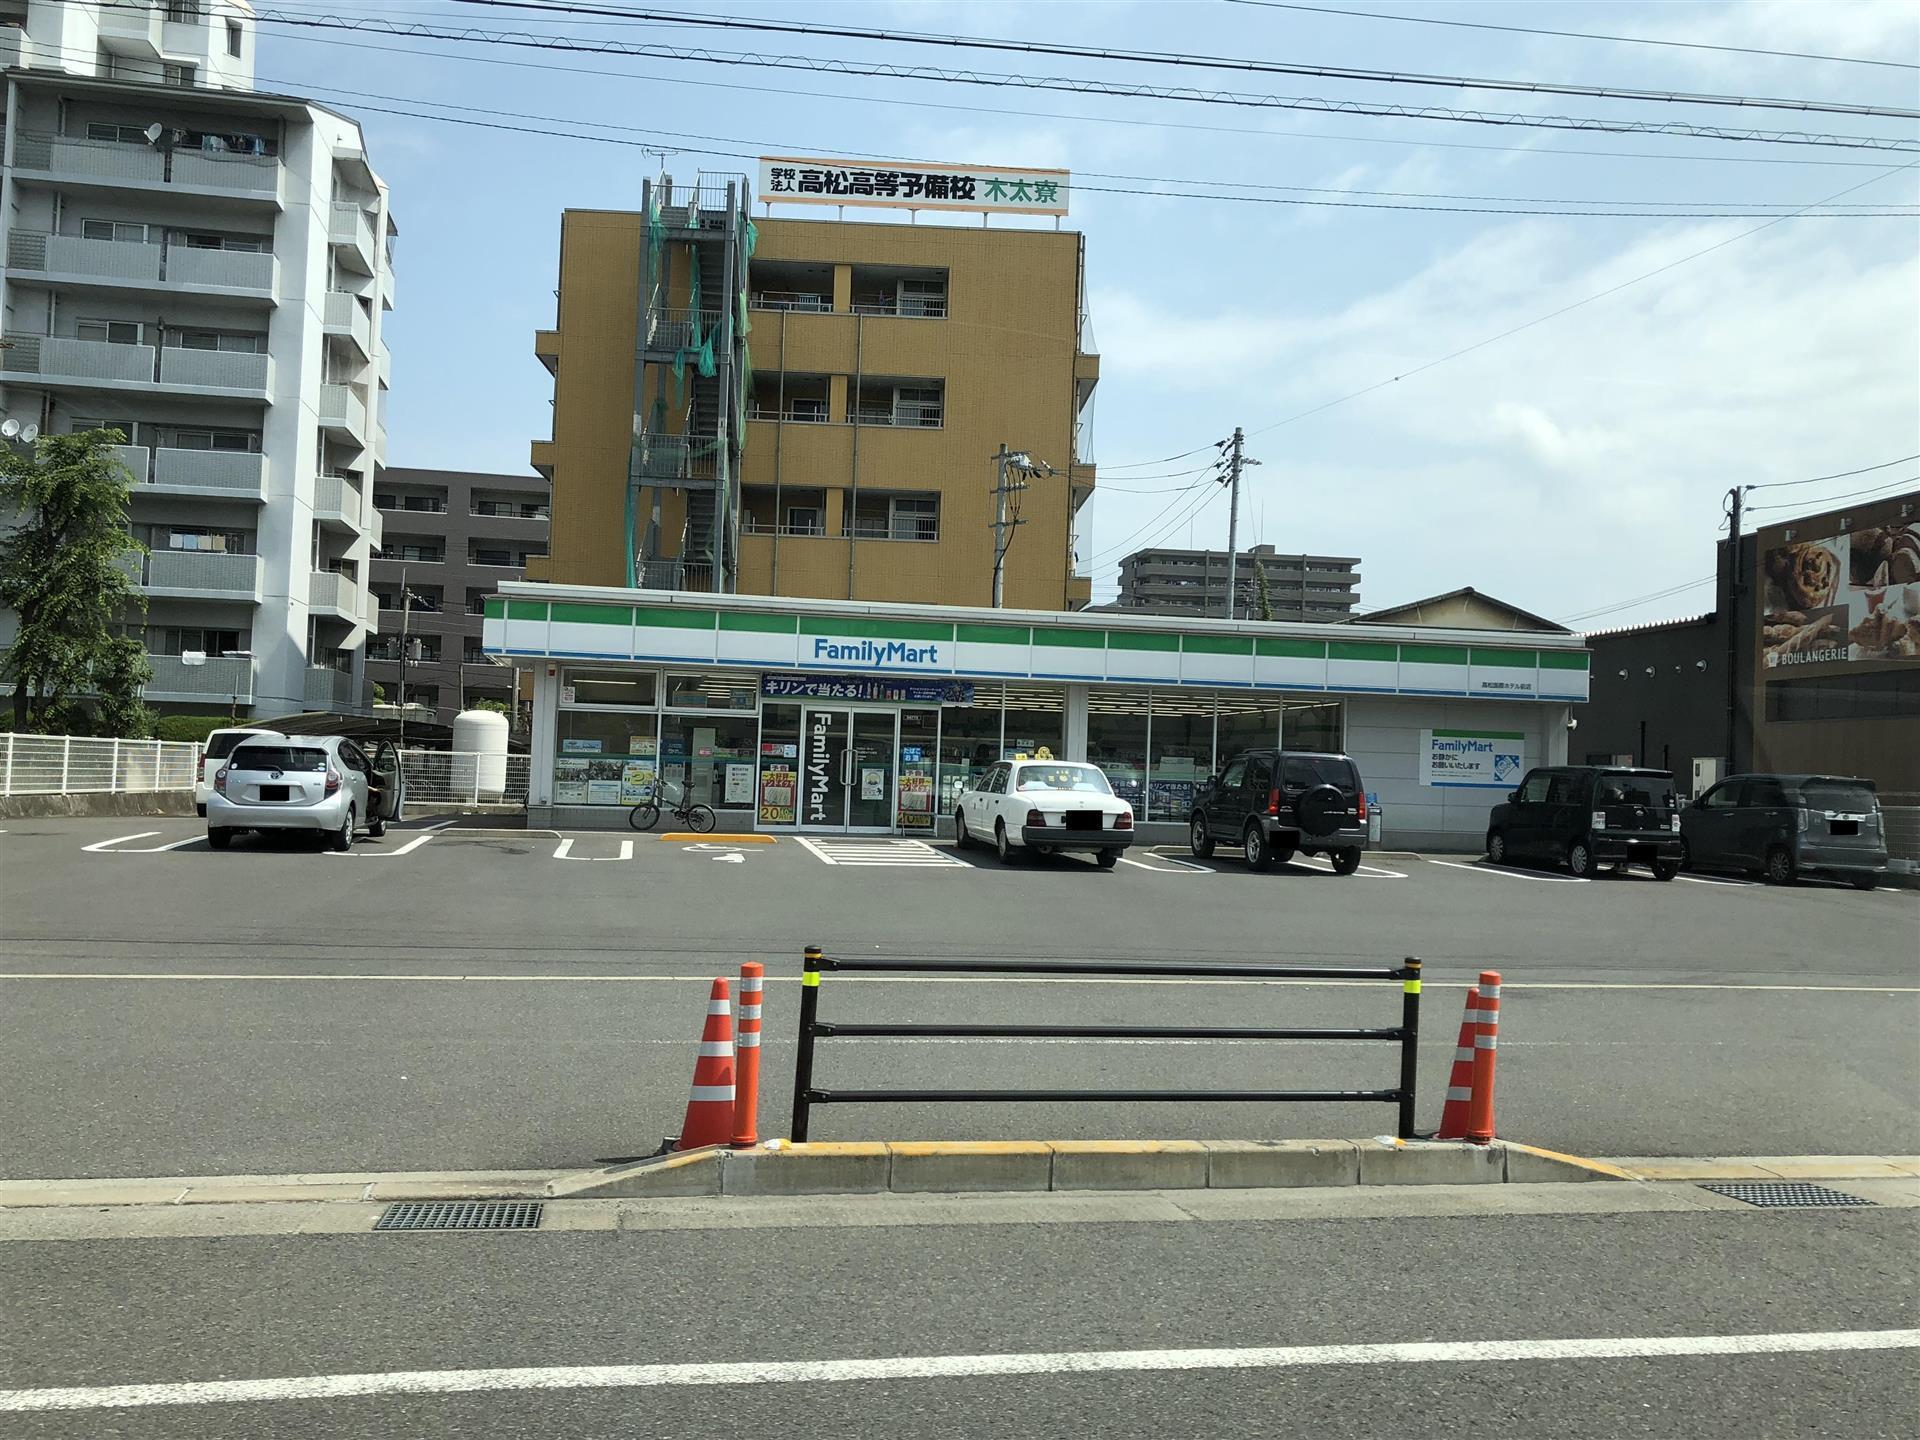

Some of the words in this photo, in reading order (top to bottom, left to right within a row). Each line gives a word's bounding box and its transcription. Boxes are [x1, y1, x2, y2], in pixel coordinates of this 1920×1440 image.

[771, 168, 796, 179] 学校
[770, 179, 796, 192] 法人
[798, 168, 976, 201] 高松高等予備校
[983, 177, 1059, 204] 木太寮
[814, 638, 938, 666] FamilyMart
[1781, 647, 1848, 665] BOULANGERIE
[903, 746, 921, 755] たばこ
[1431, 739, 1494, 754] FamilyMart
[807, 712, 832, 822] FamilyMart
